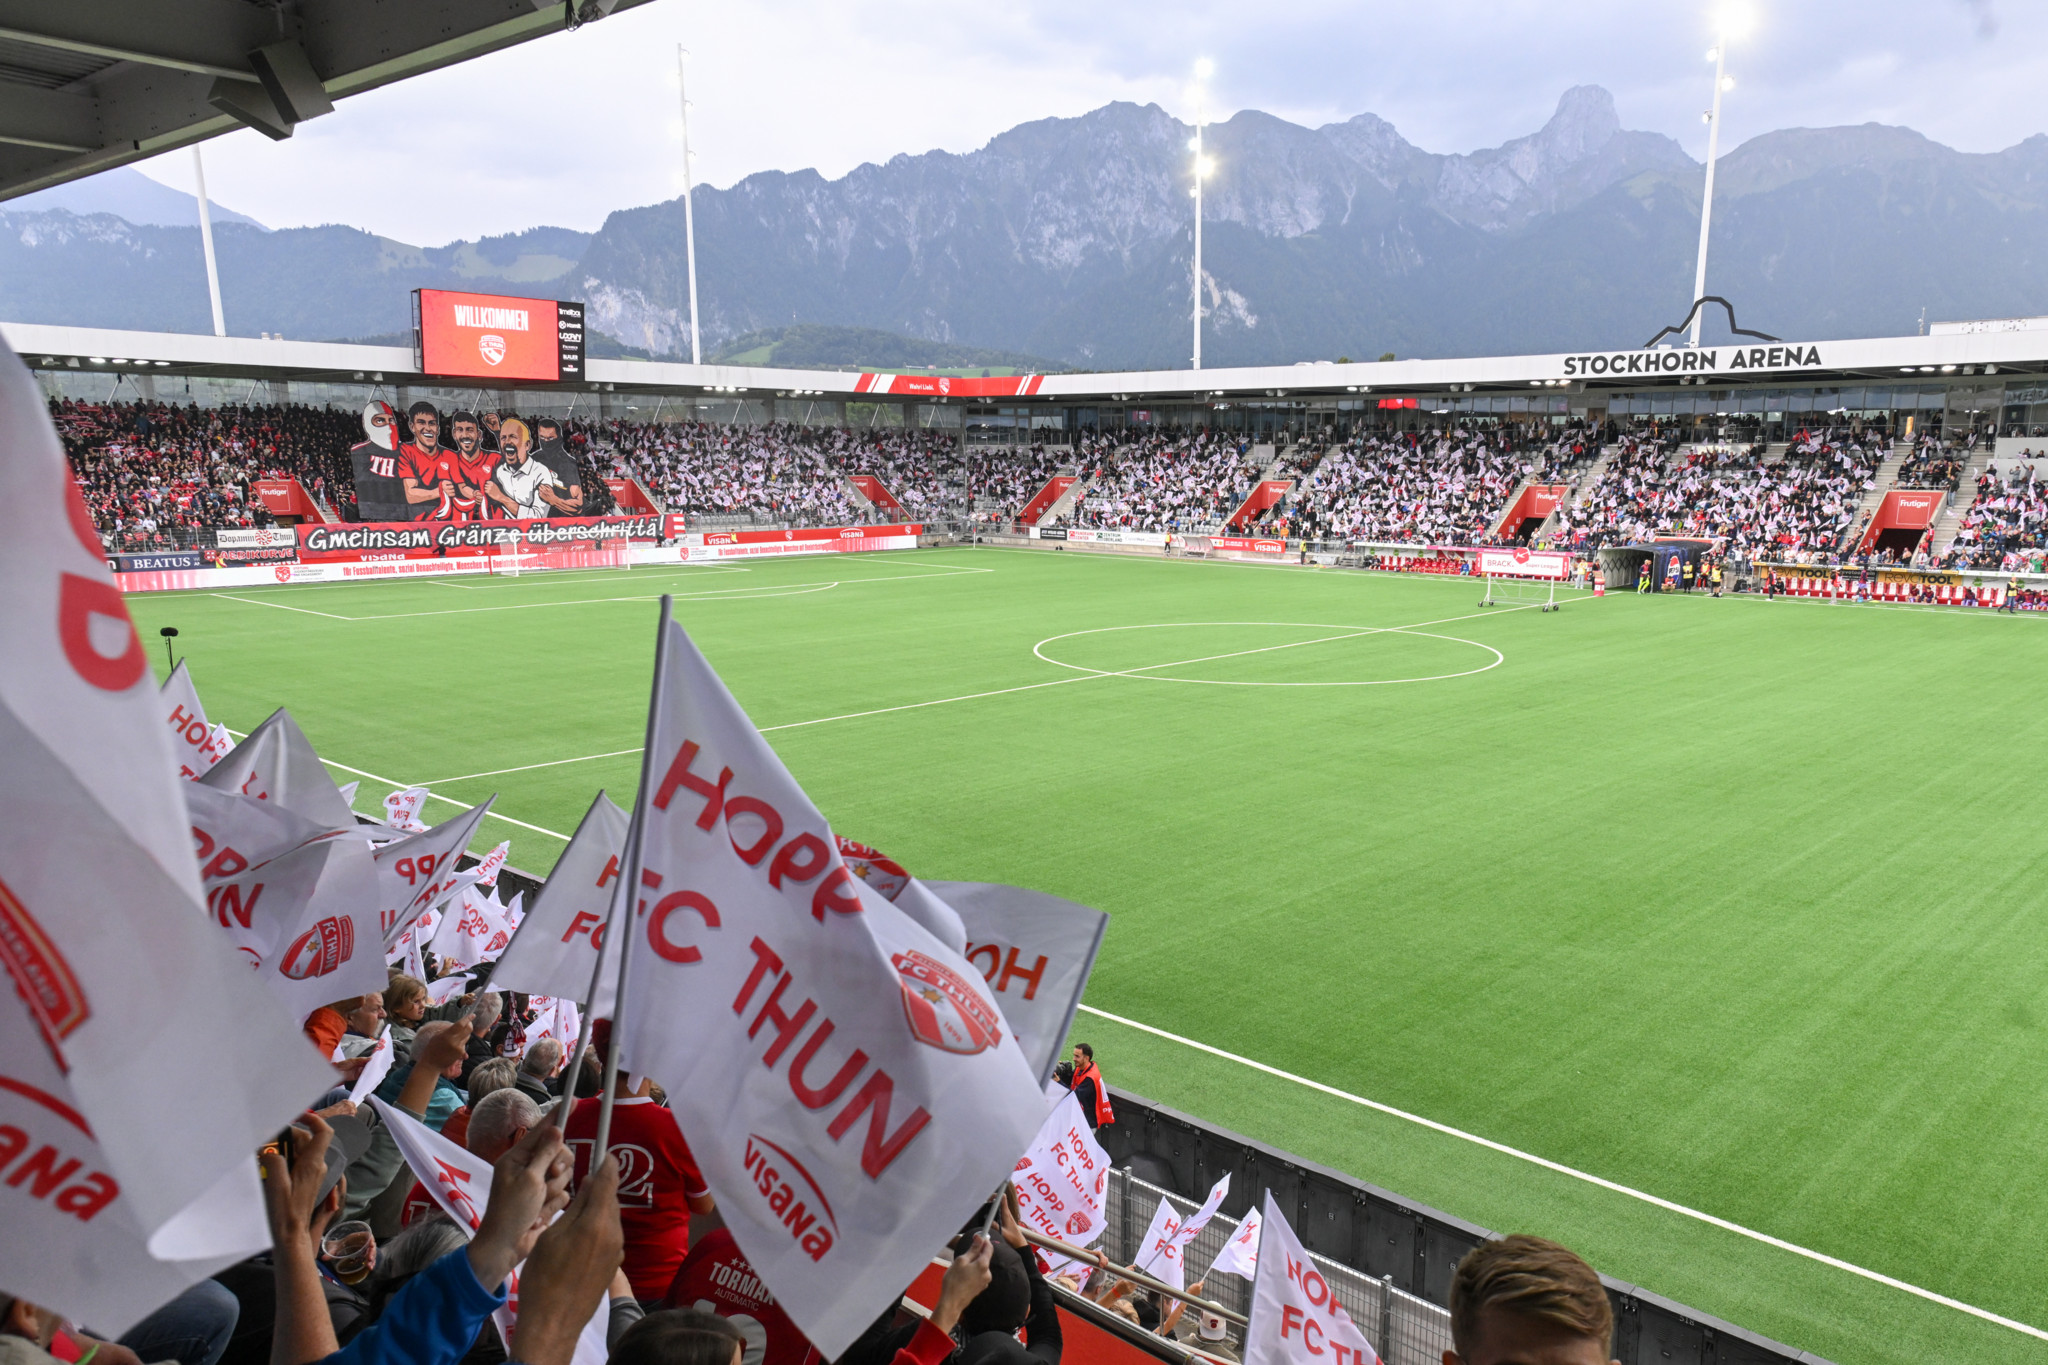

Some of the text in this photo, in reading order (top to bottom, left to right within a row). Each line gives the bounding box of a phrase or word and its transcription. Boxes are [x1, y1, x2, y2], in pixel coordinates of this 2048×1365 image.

[454, 305, 529, 331] WILLKOMMEN
[1563, 345, 1822, 376] STOCKHORN ARENA
[370, 455, 395, 478] TH
[261, 488, 287, 496] Frutiger
[1900, 499, 1928, 508] Frutiger
[219, 532, 293, 543] Dopamin Thun
[308, 516, 664, 551] Gmeinsam Gränze überschrittä!
[133, 557, 191, 569] BEATUS
[221, 548, 294, 560] AEBIKURVE
[1487, 559, 1514, 568] BRACK.
[651, 739, 863, 922] HOPP
[322, 921, 338, 969] FC THUN
[898, 959, 929, 978] FC
[731, 936, 931, 1180] THUN
[1050, 1142, 1069, 1166] FC
[1068, 1126, 1094, 1170] HOPP
[1027, 1172, 1065, 1211] HOPP
[714, 1288, 760, 1312] AUTOMATIC
[1281, 1304, 1325, 1355] FC
